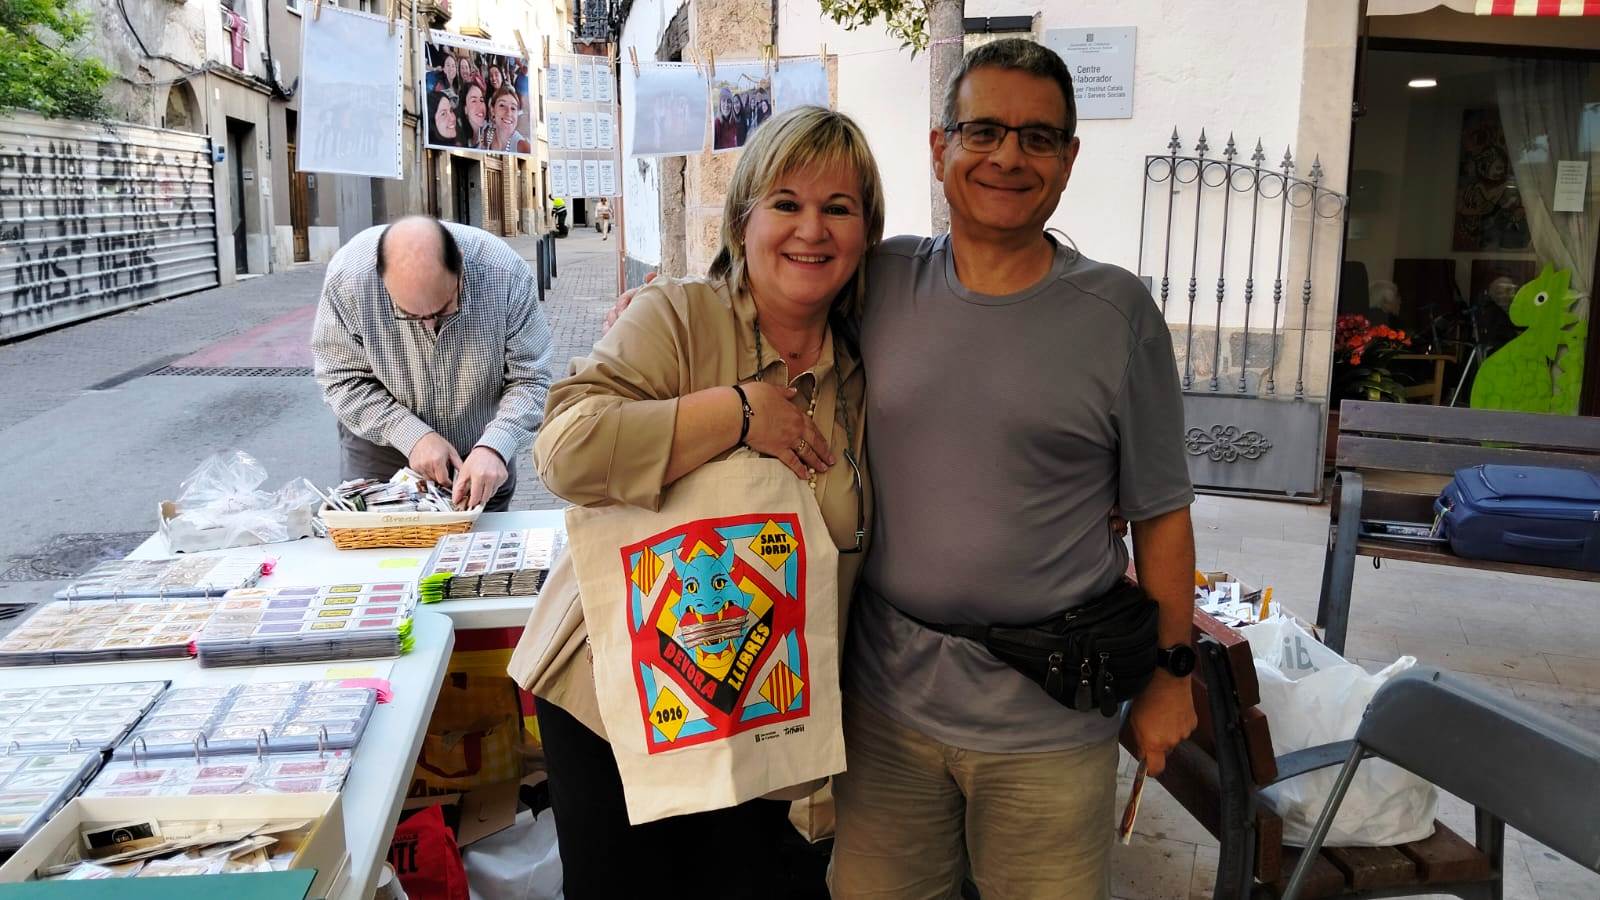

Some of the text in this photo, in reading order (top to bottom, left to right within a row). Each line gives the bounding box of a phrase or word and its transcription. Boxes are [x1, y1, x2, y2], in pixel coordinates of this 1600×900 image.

[1077, 65, 1101, 74] Centre
[1073, 75, 1112, 83] l·laborador
[760, 533, 787, 544] SANT
[760, 543, 791, 556] JORDI
[663, 622, 771, 700] DEVORA LLIBRES
[656, 705, 683, 724] 2026
